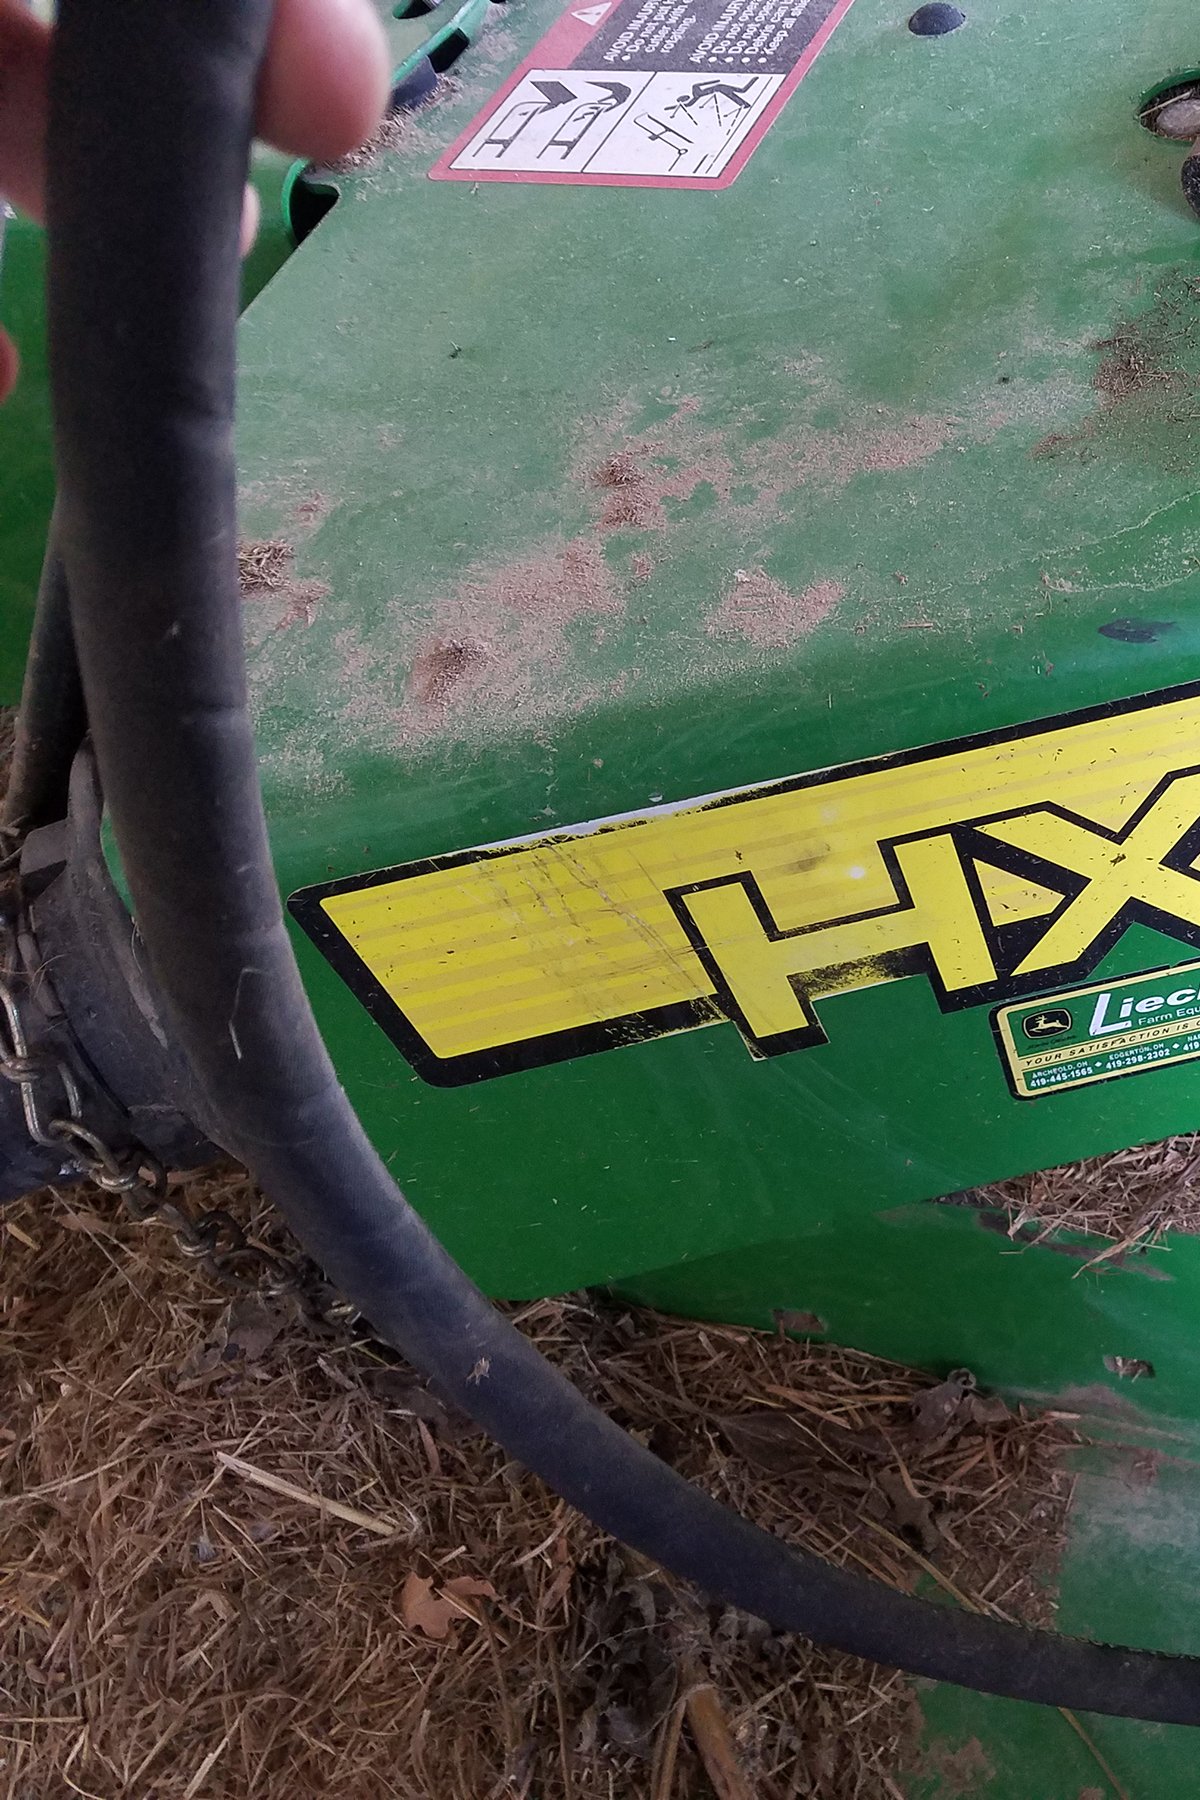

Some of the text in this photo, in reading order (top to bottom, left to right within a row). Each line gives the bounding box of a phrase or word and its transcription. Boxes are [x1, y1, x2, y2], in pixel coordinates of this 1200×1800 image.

[603, 32, 634, 62] AVOID
[625, 39, 645, 53] Do
[640, 22, 659, 38] not
[689, 33, 720, 63] AVOID
[711, 40, 731, 54] Do
[728, 40, 748, 54] Do
[744, 24, 776, 54] Debris
[1138, 1013, 1173, 1026] Farm
[1025, 1053, 1062, 1067] YOUR
[1069, 1027, 1170, 1057] SATISFACTION
[1176, 1022, 1190, 1031] IS
[1152, 1042, 1164, 1050] OH
[1076, 1060, 1088, 1068] OH
[1105, 1048, 1170, 1070] 419-298-2302
[1030, 1066, 1093, 1087] 419-445-1565
